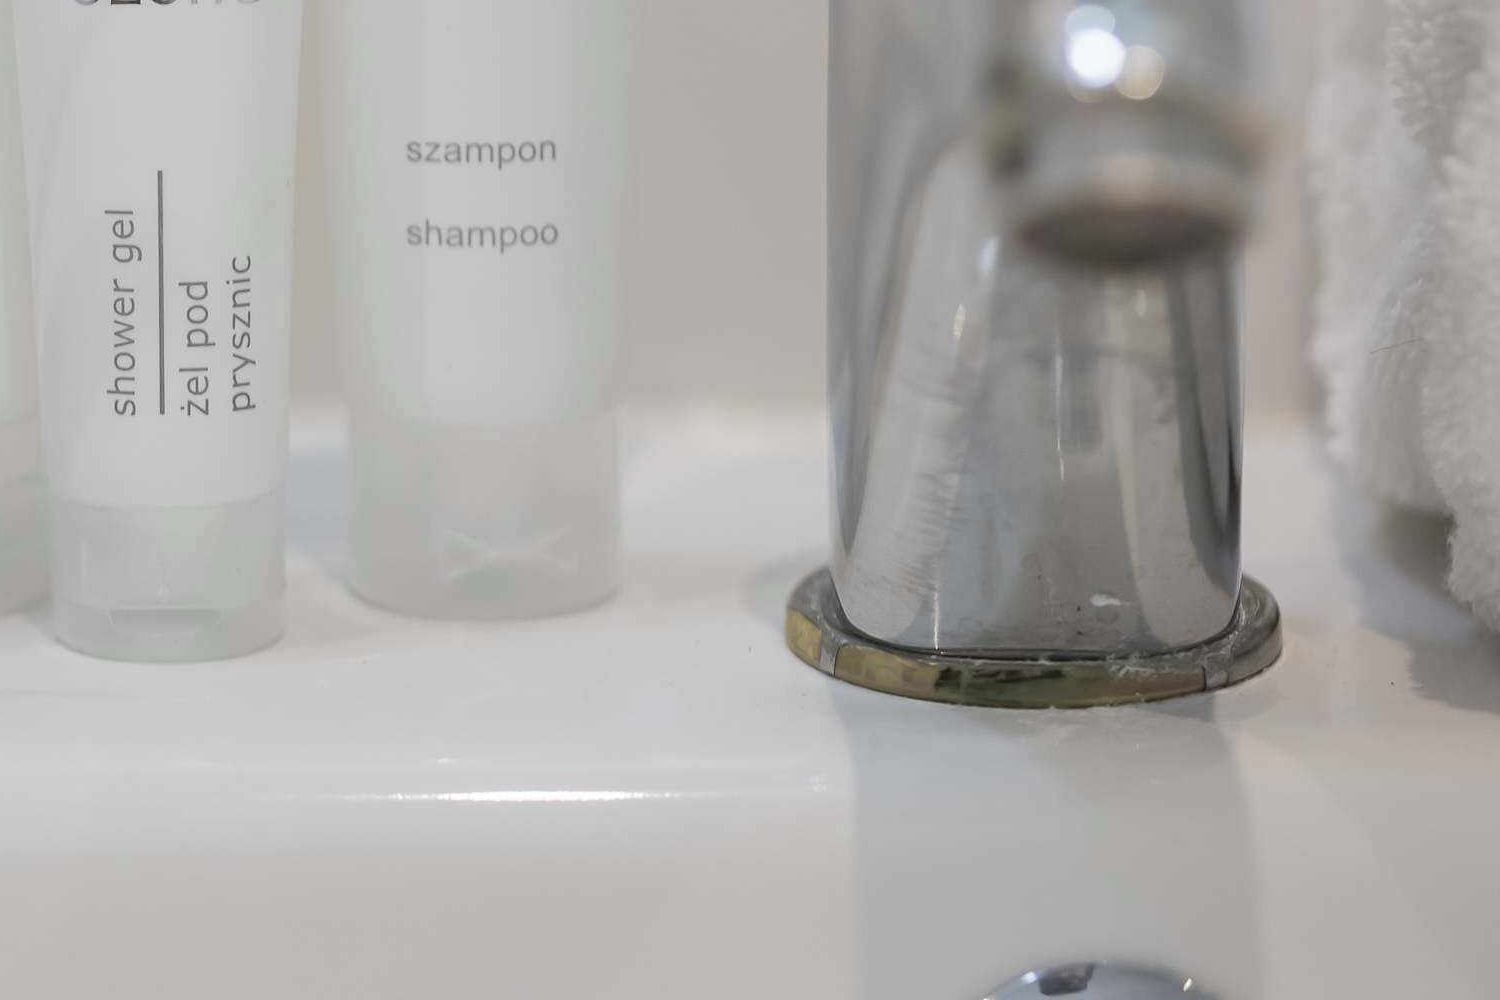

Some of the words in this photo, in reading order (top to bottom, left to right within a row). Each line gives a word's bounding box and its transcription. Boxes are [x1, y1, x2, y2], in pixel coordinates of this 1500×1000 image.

[406, 139, 557, 172] szampon
[104, 209, 143, 264] gel
[406, 218, 559, 255] shampoo
[178, 280, 217, 348] pod
[225, 254, 257, 413] prysznic
[106, 278, 136, 417] shower
[178, 366, 210, 417] żel
